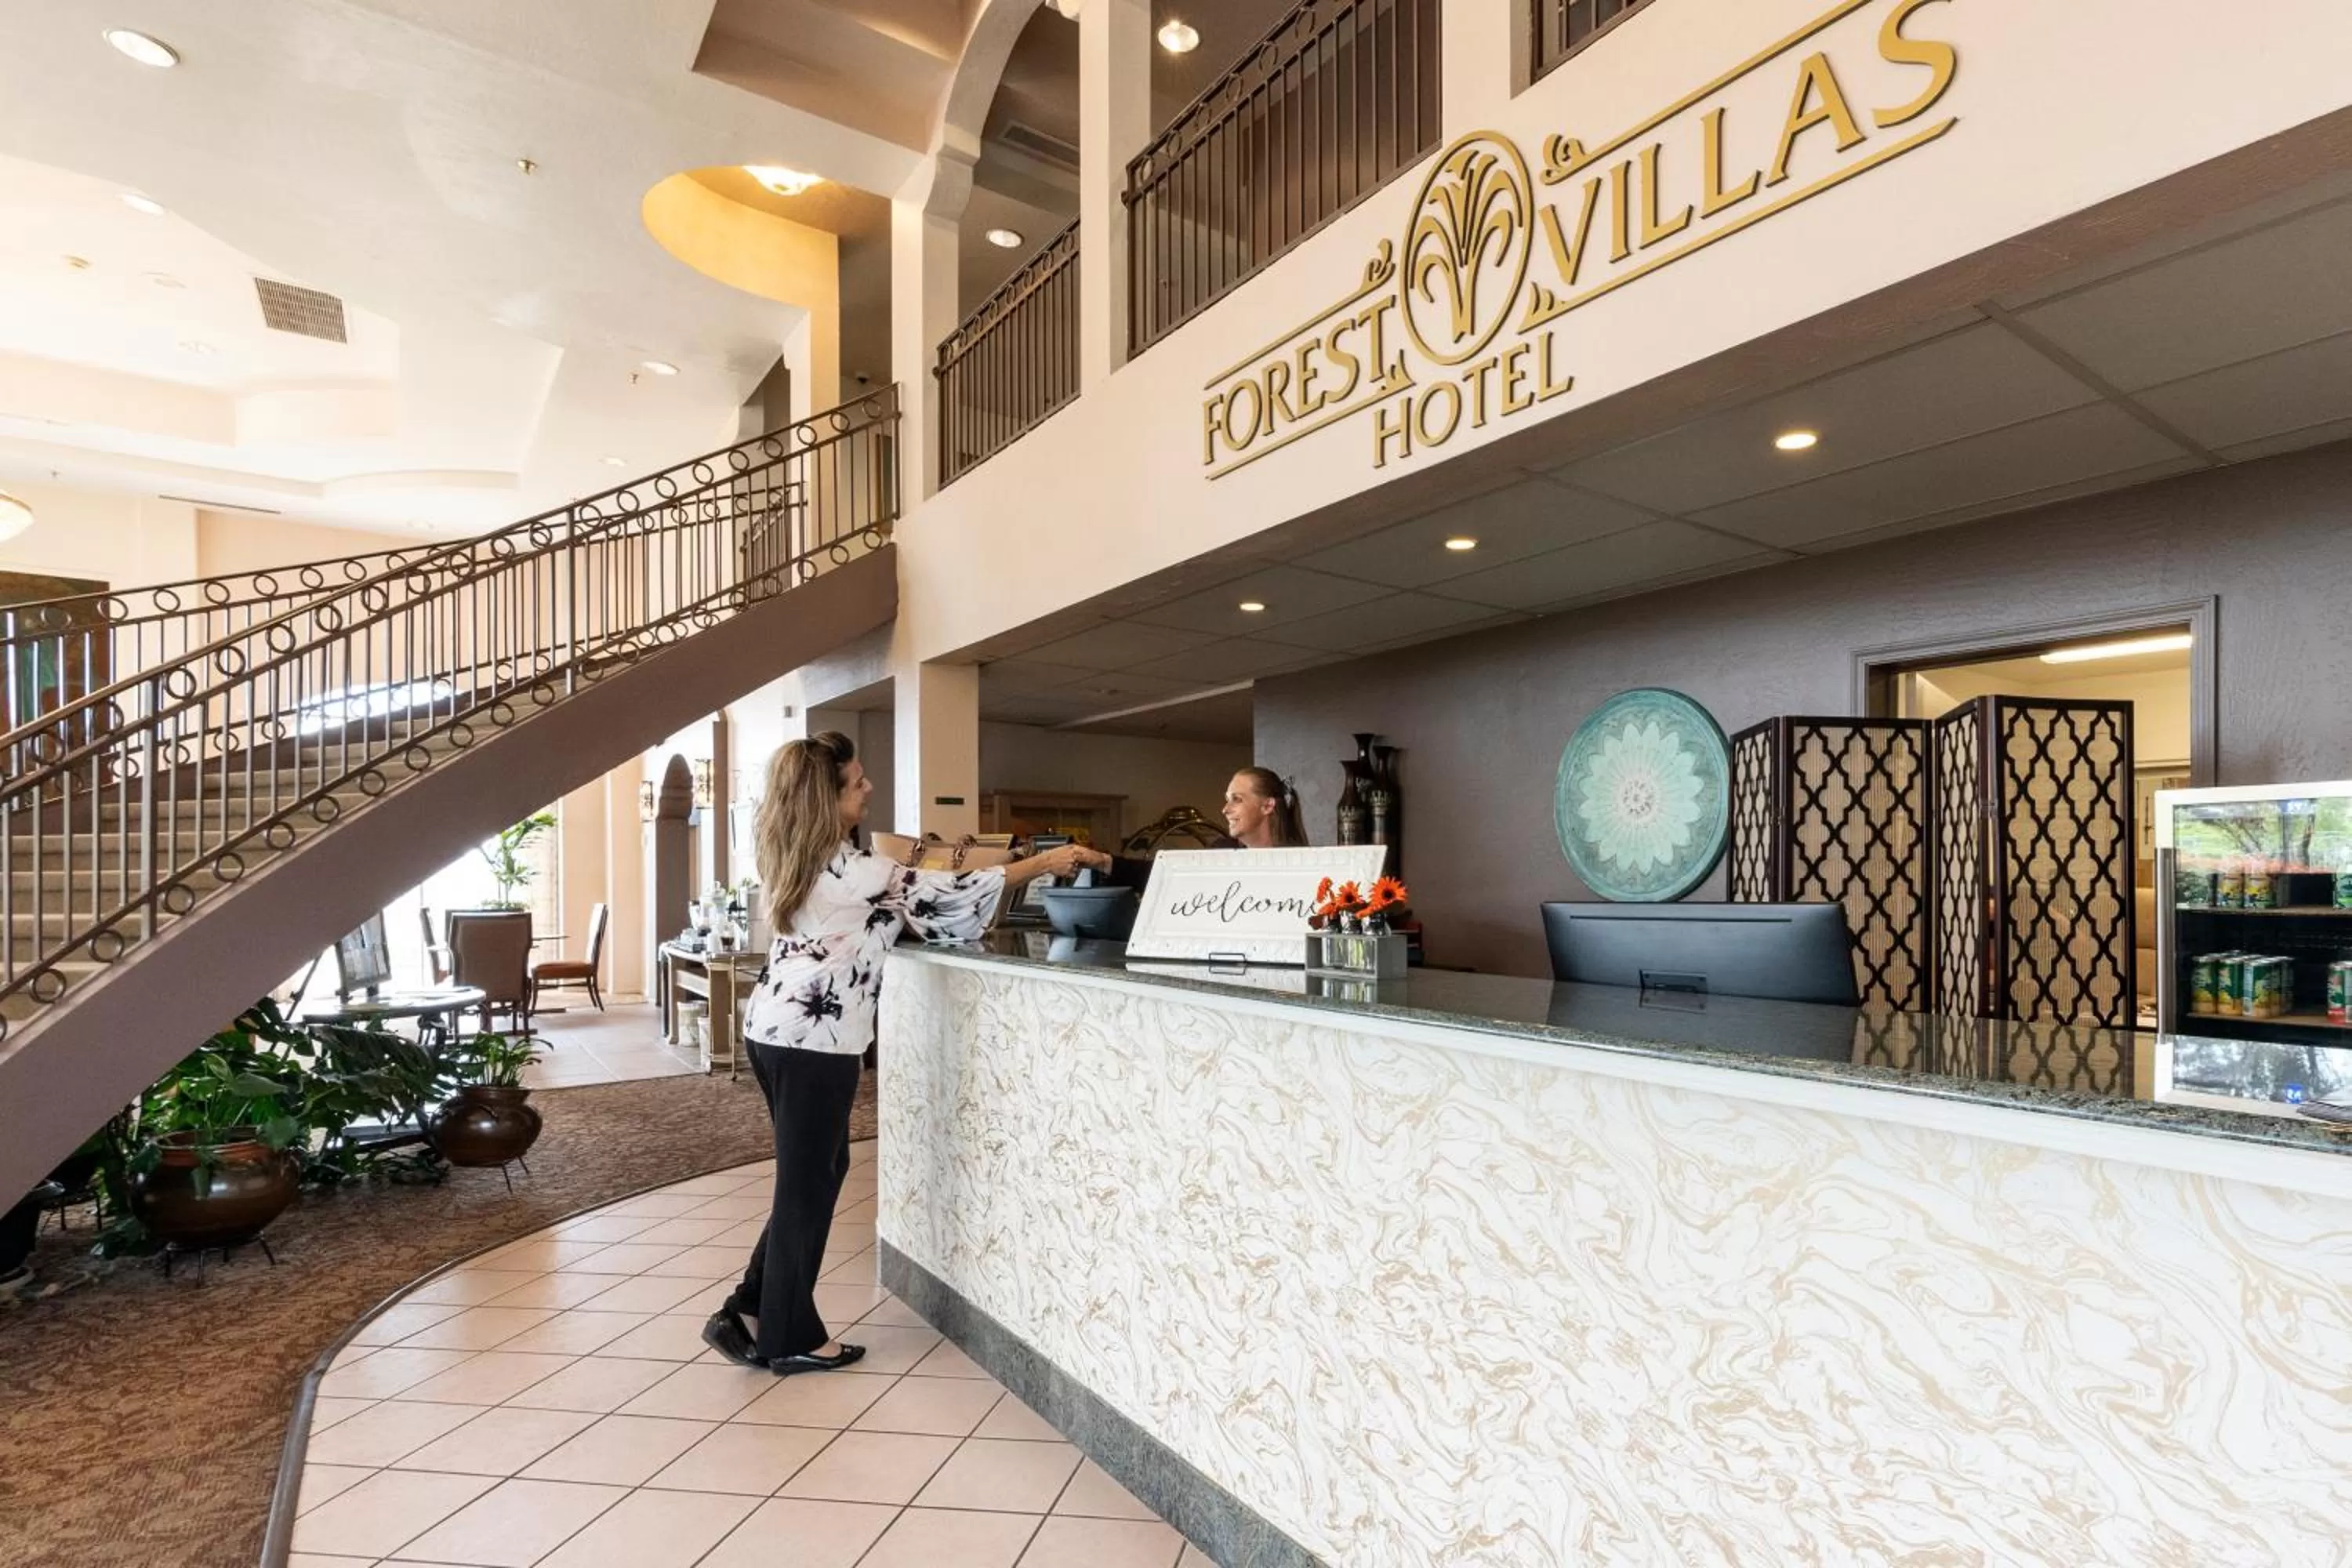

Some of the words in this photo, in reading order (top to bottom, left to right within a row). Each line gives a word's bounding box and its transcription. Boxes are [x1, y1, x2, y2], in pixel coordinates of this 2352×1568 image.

[1203, 295, 1396, 465] FOREST
[1538, 0, 1958, 285] VILLAS
[1373, 332, 1574, 468] HOTEL
